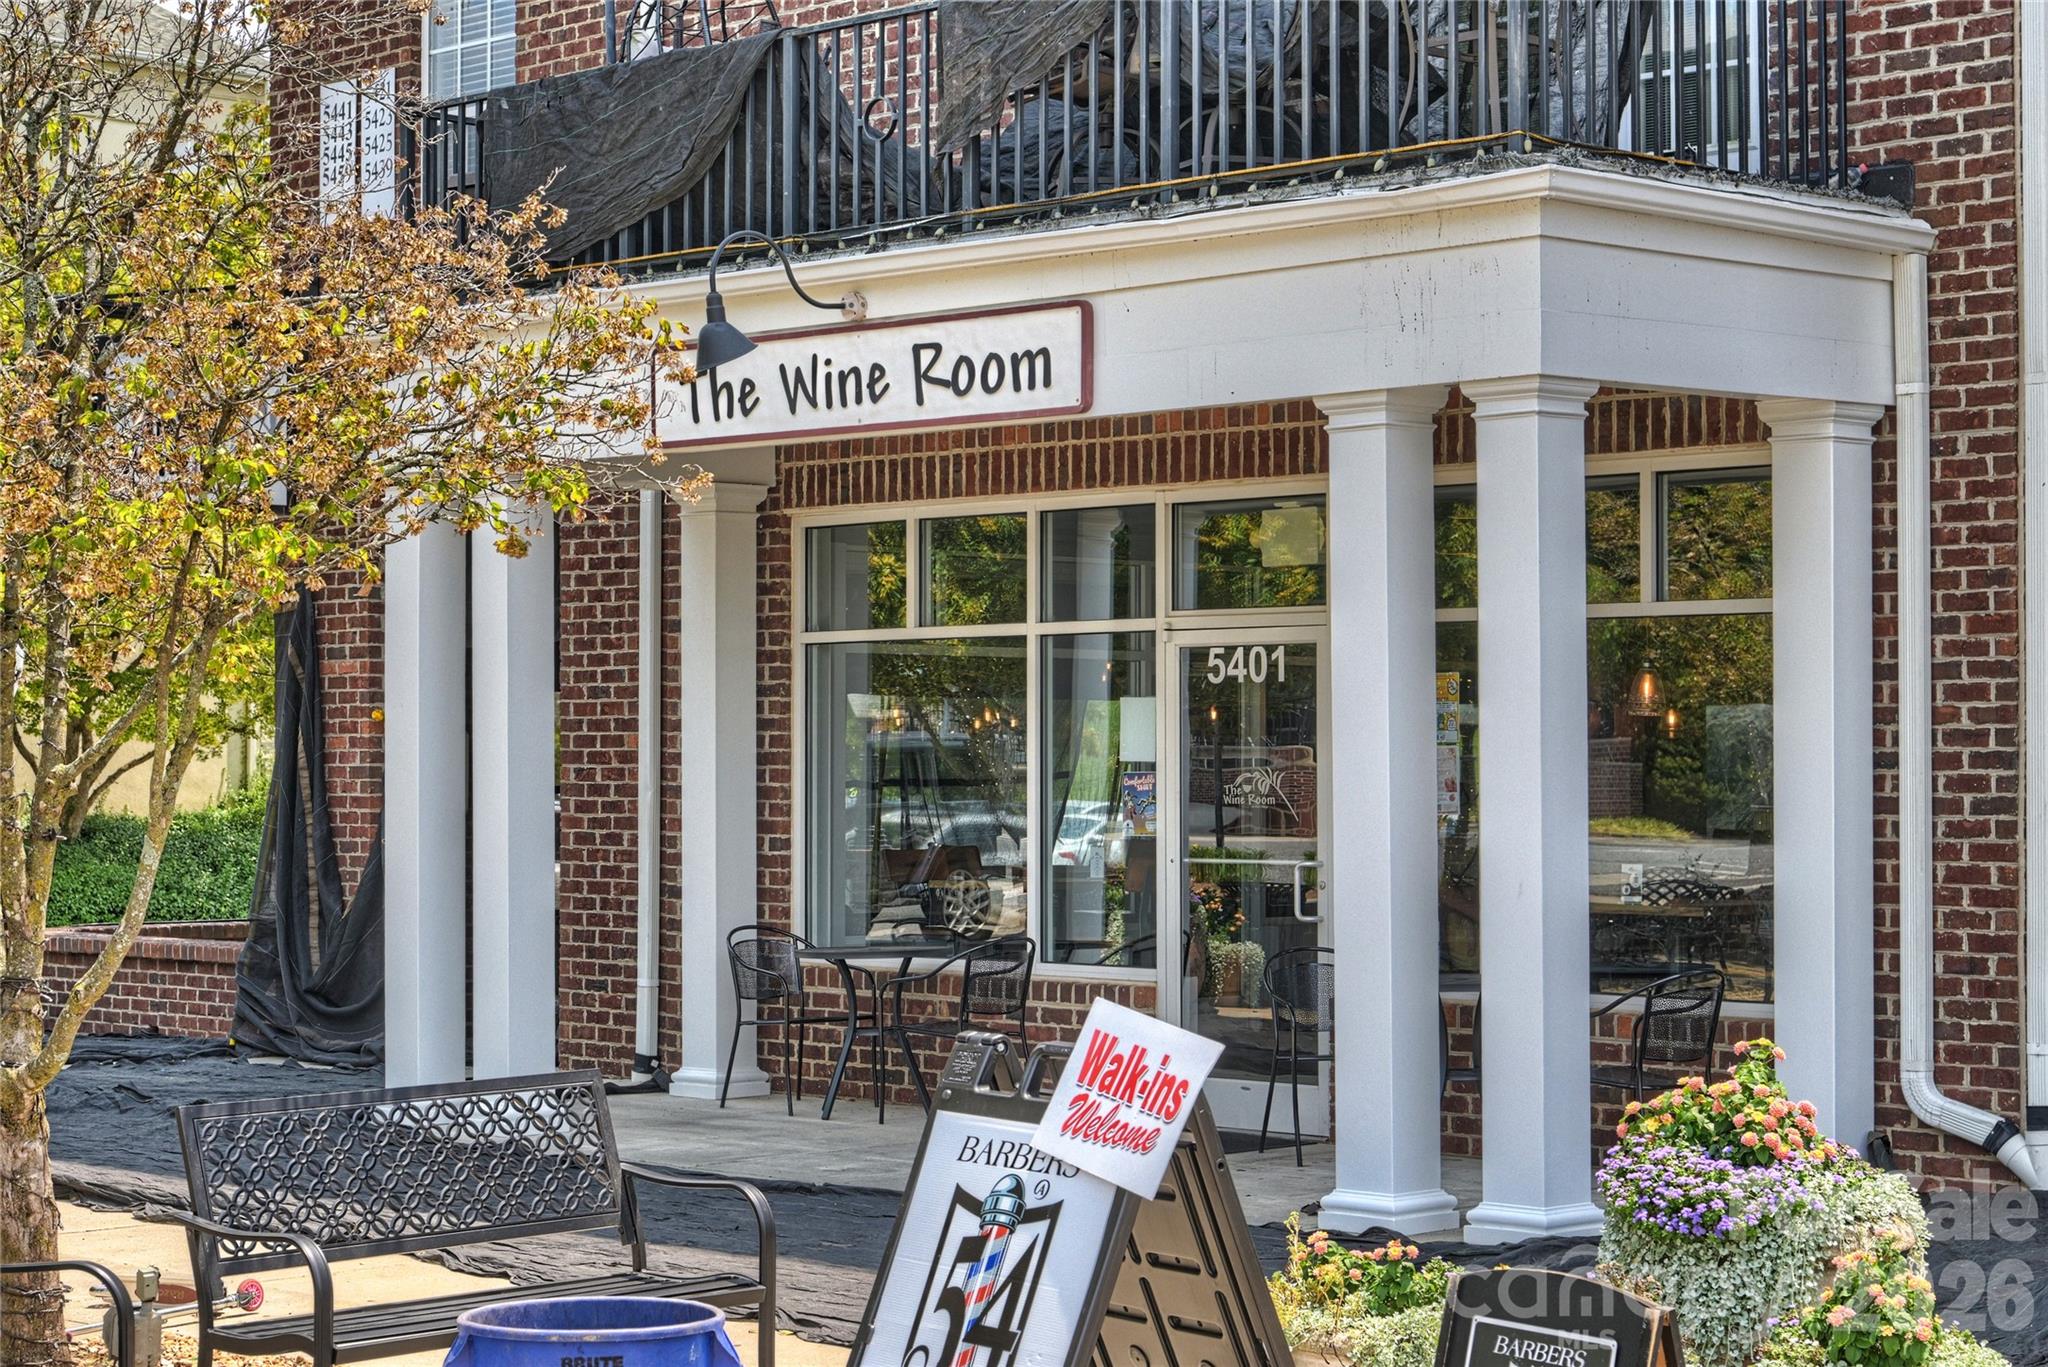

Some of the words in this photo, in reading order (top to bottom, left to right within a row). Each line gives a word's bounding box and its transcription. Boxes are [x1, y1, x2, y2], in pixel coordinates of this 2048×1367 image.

[322, 101, 352, 124] 5441
[322, 142, 353, 166] 5445
[364, 132, 393, 156] 5425
[364, 158, 393, 182] 5439
[679, 366, 760, 424] The
[779, 352, 890, 415] Wine
[911, 341, 1052, 407] Room
[1207, 645, 1285, 685] 5401
[1223, 784, 1242, 795] The
[1223, 795, 1246, 805] Wine
[1247, 794, 1276, 805] Room
[1076, 1028, 1190, 1125] Walk-ins
[1060, 1092, 1162, 1155] Welcome
[1492, 1334, 1588, 1367] BARBERS
